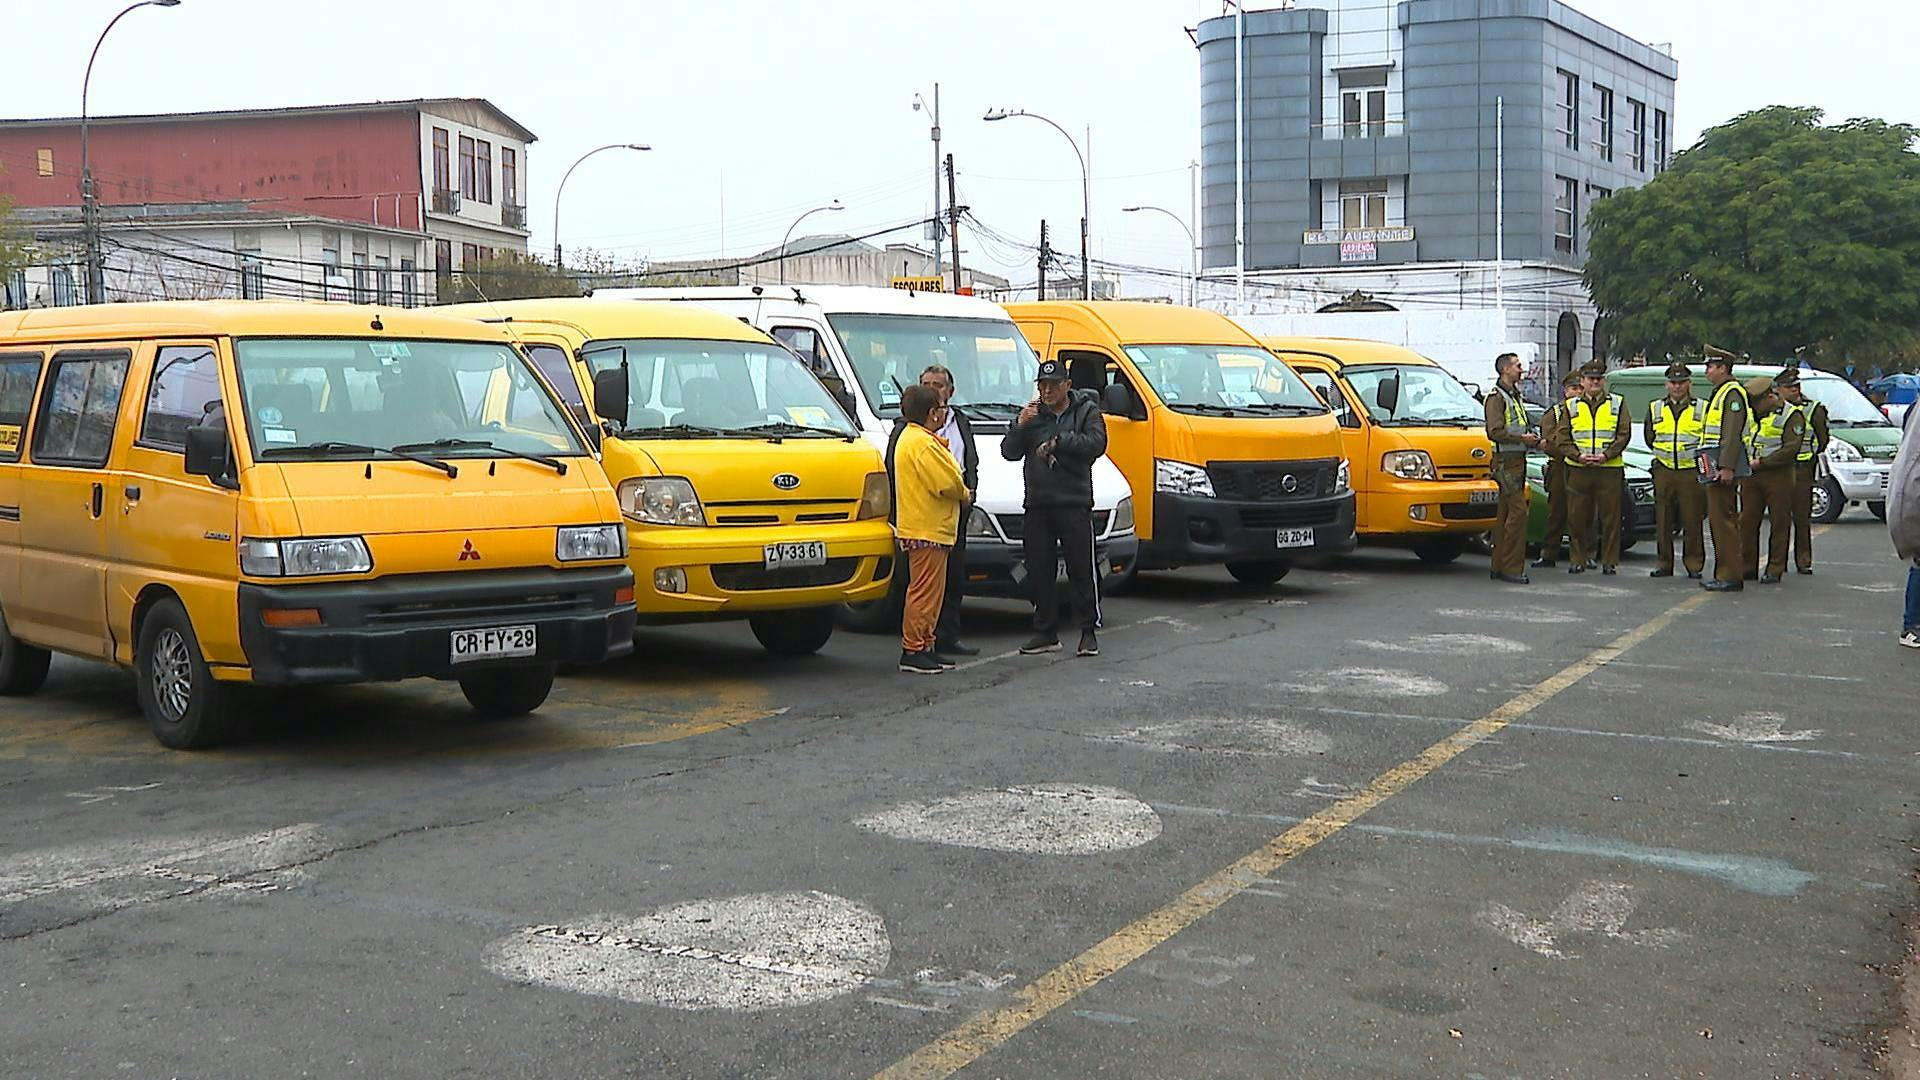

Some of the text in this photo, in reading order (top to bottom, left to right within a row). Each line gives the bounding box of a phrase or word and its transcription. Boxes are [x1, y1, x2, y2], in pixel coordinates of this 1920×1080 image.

[1308, 229, 1410, 243] REAURANTE
[893, 280, 941, 293] ESCOLARES
[776, 475, 798, 487] KIA
